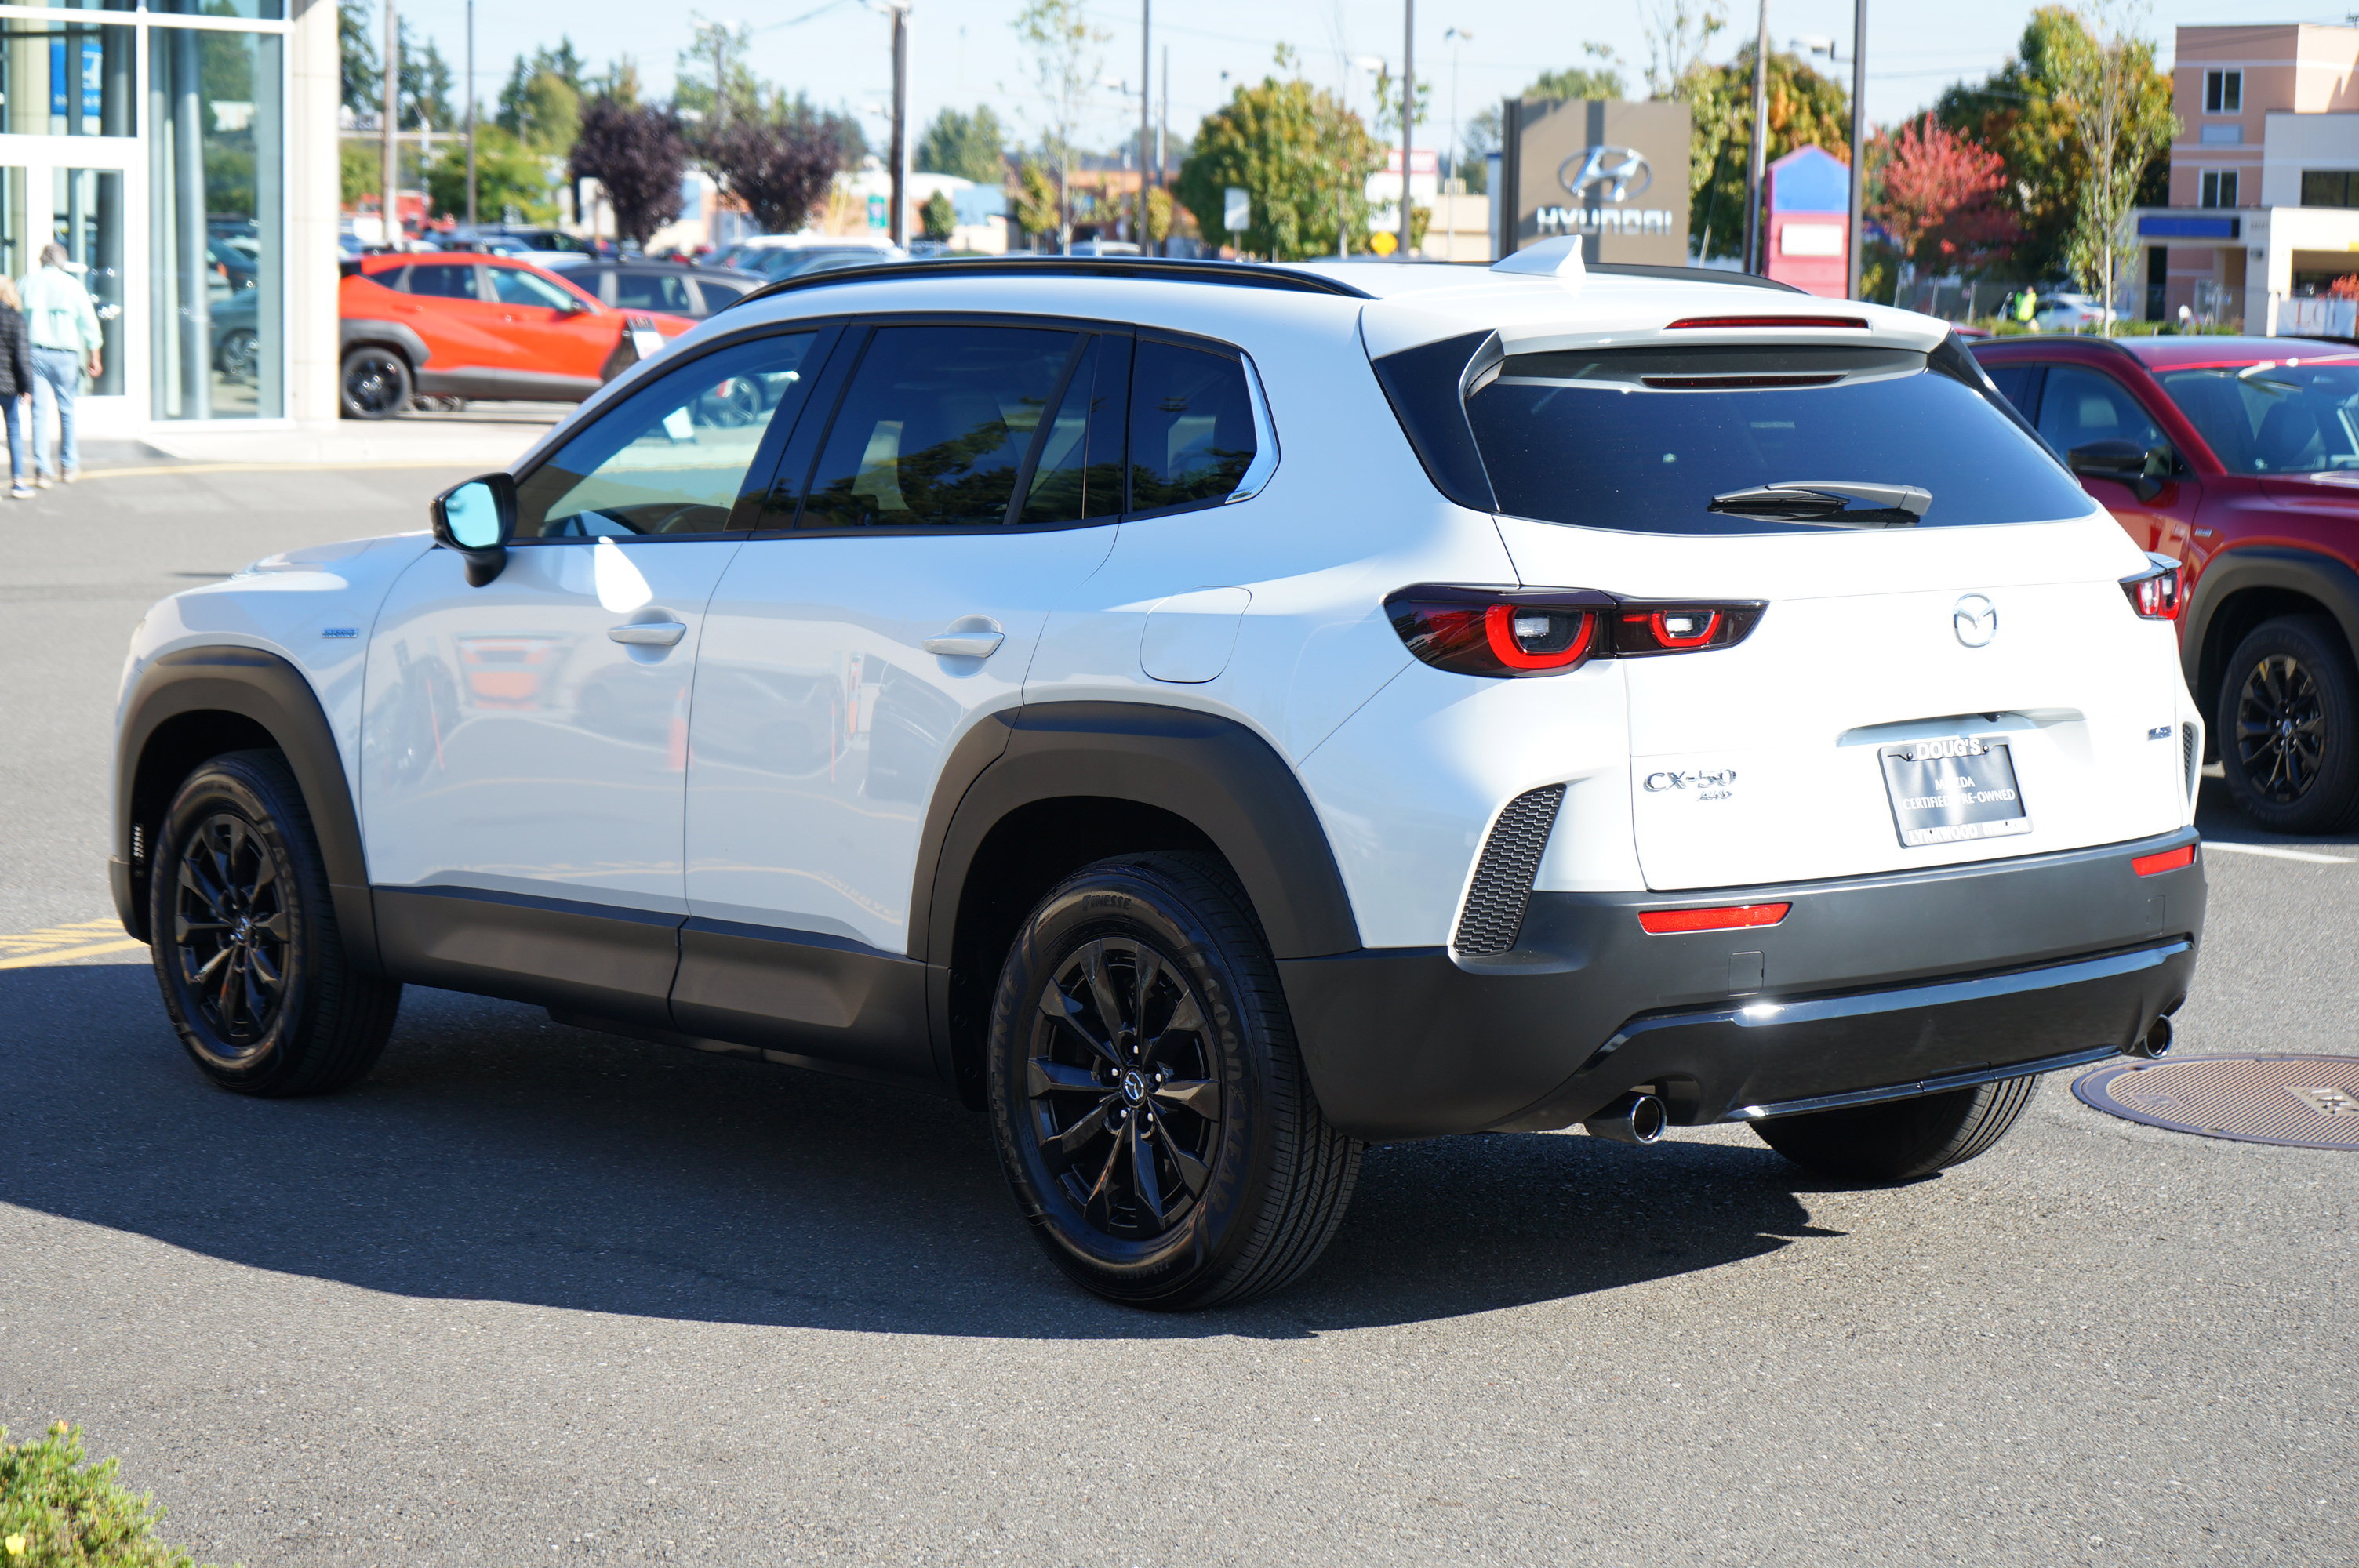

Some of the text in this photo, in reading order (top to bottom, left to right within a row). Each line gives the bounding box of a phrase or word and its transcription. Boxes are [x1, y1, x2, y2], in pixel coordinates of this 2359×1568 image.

[1537, 207, 1672, 235] HYUNDAI
[1916, 739, 1981, 760] DOUG'S
[1643, 769, 1736, 792] CX-50
[1935, 776, 1976, 790] MZDA
[1903, 789, 2016, 810] CERTIFIED RE-OWNED
[1083, 895, 1131, 910] FINESSE
